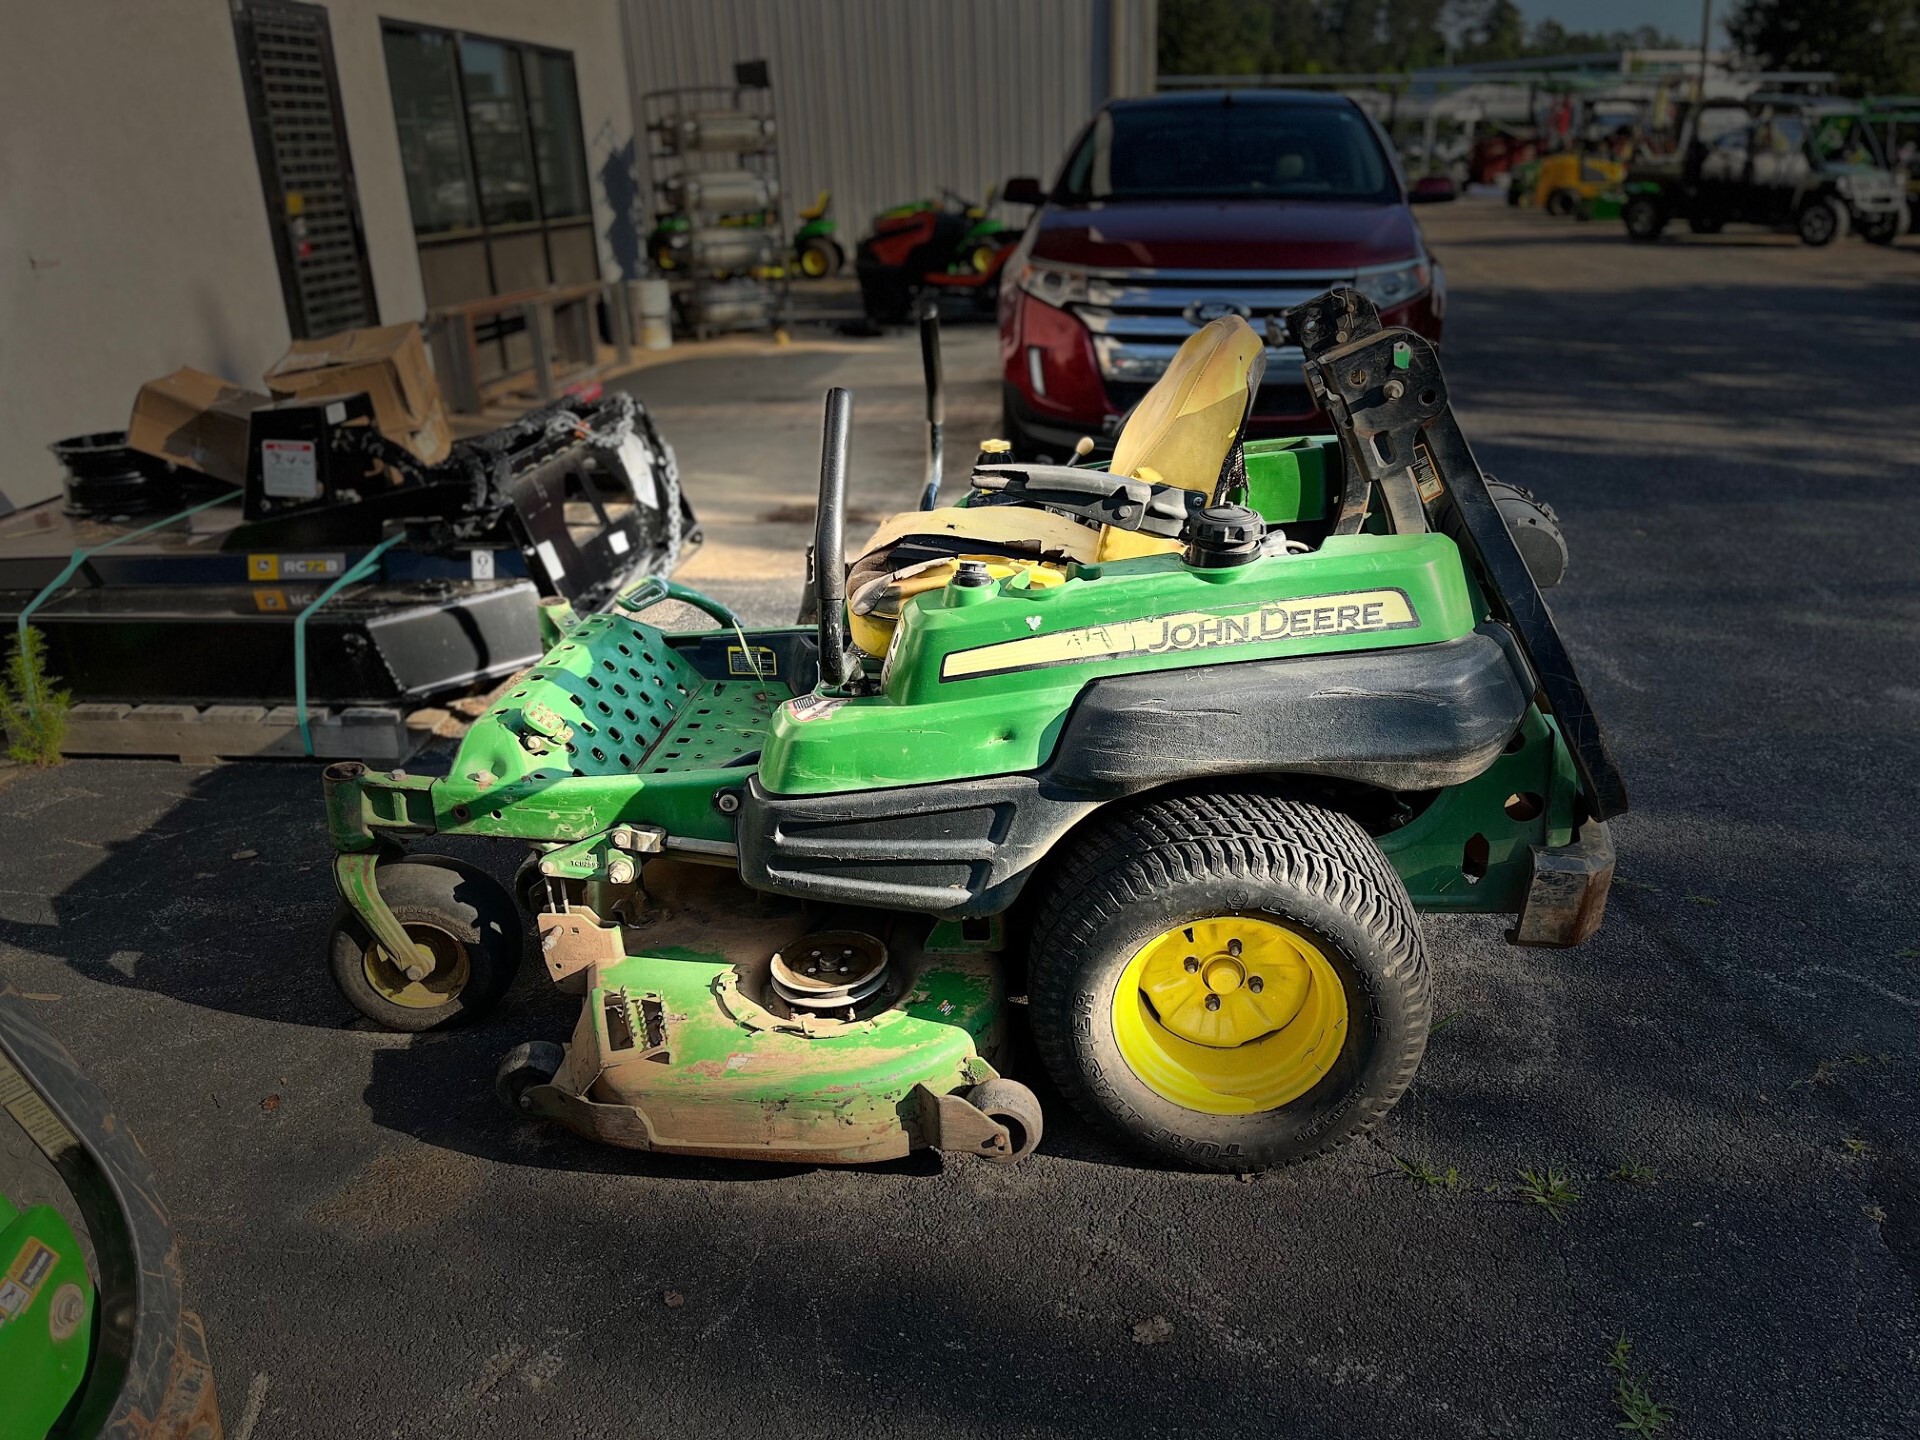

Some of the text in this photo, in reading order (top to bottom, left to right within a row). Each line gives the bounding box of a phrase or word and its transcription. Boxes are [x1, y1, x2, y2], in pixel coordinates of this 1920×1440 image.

[284, 559, 338, 574] RC72B
[1149, 602, 1384, 650] JOHN DEERE
[1071, 990, 1145, 1121] MASTER
[1144, 1127, 1246, 1159] TURF
